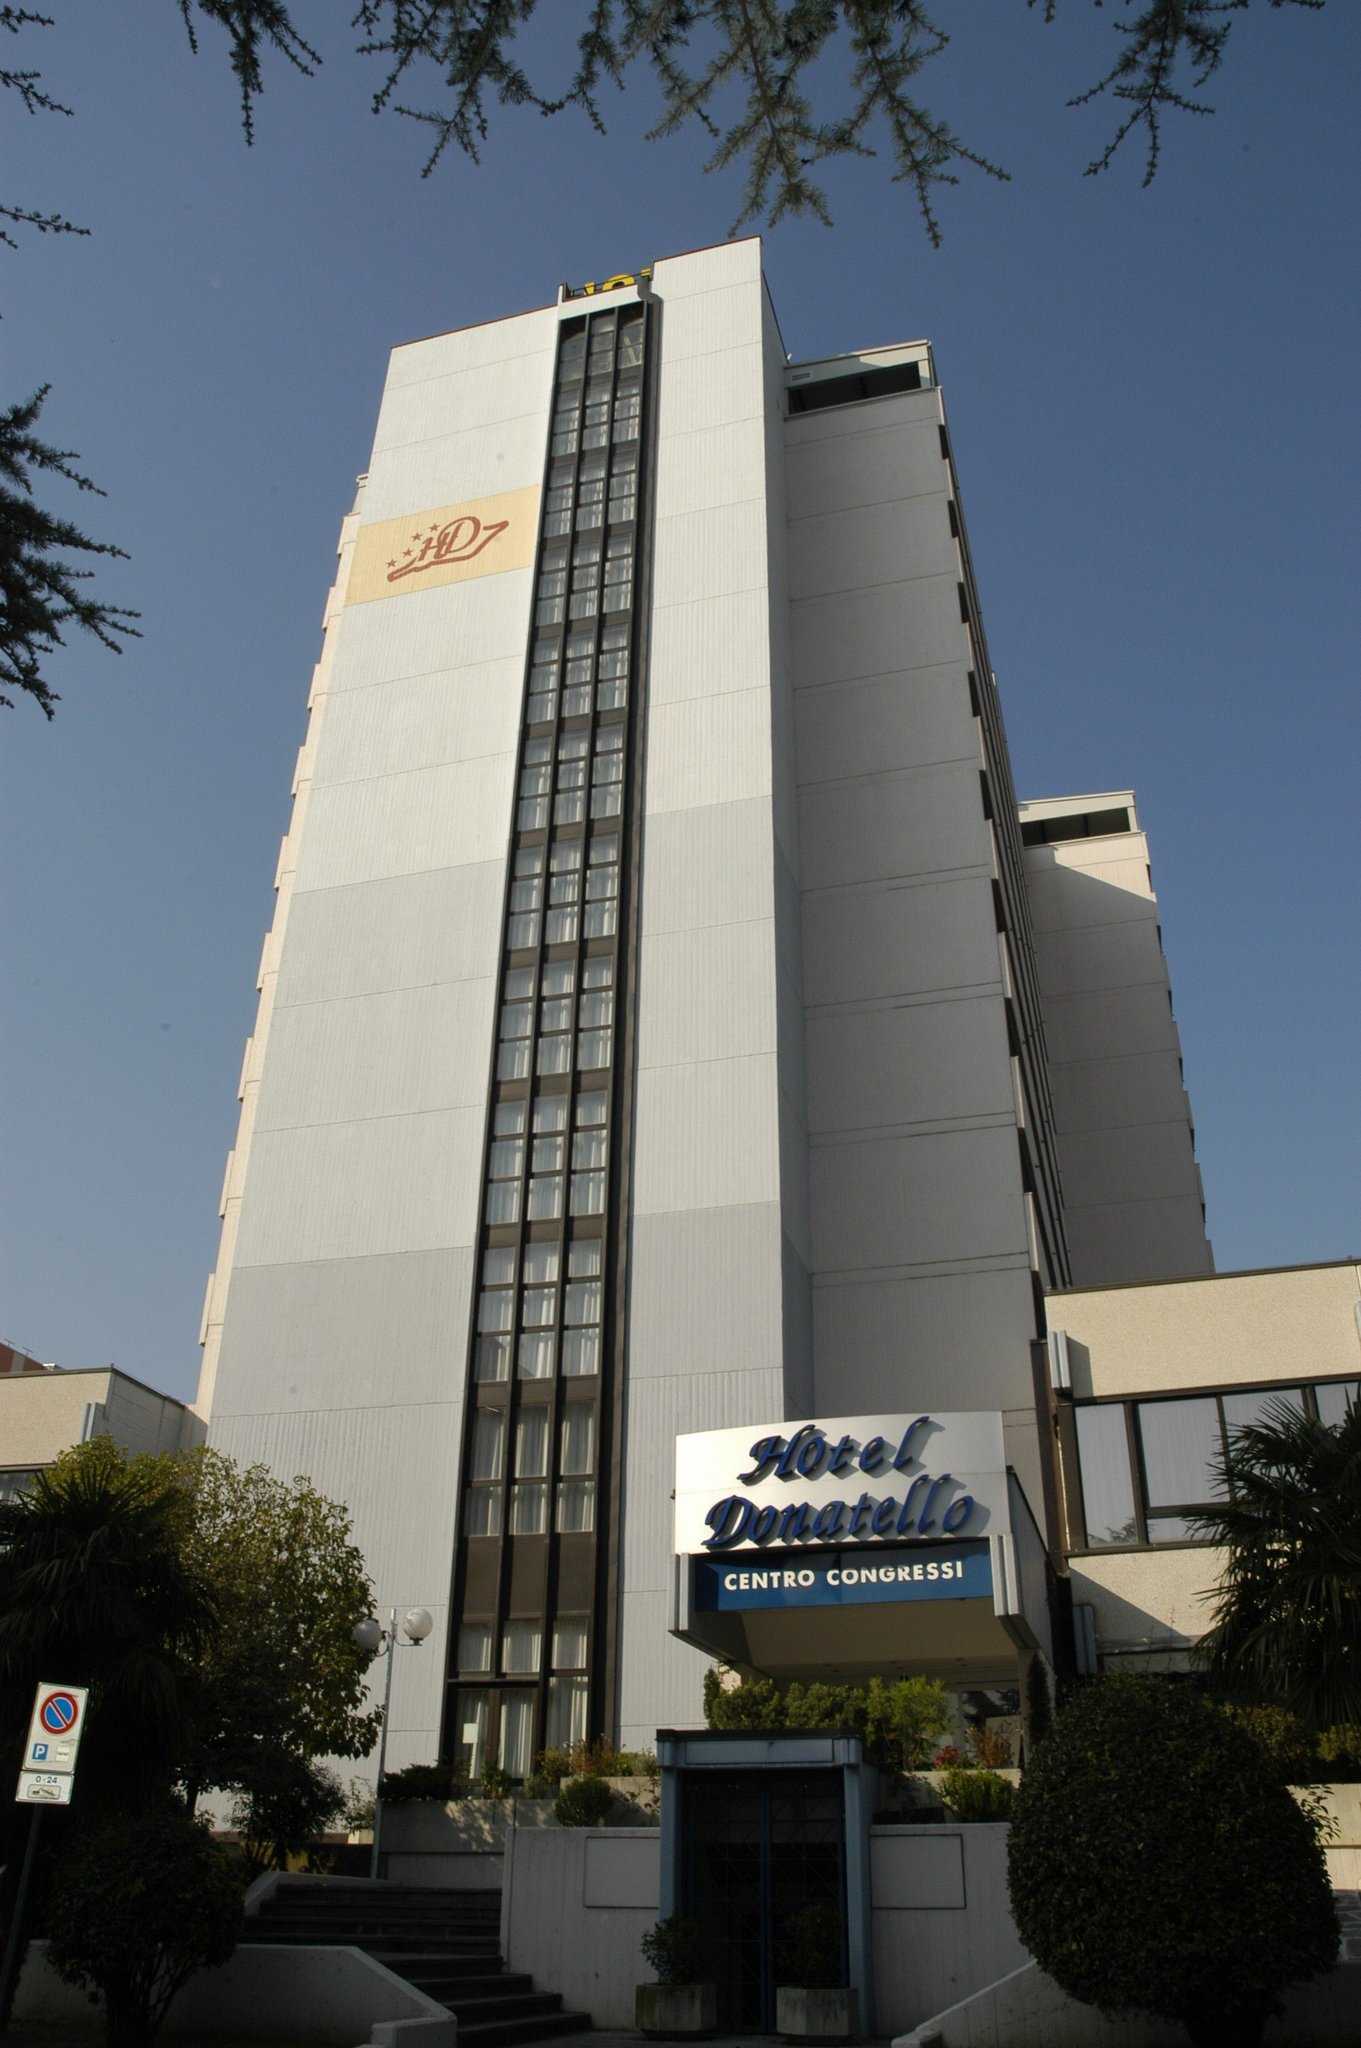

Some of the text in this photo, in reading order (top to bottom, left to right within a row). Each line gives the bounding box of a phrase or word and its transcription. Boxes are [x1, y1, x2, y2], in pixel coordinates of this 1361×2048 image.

[737, 1416, 930, 1481] Hotel
[701, 1473, 975, 1549] Donatello
[724, 1560, 963, 1591] CENTRO CONGRESSI
[35, 1745, 46, 1758] P
